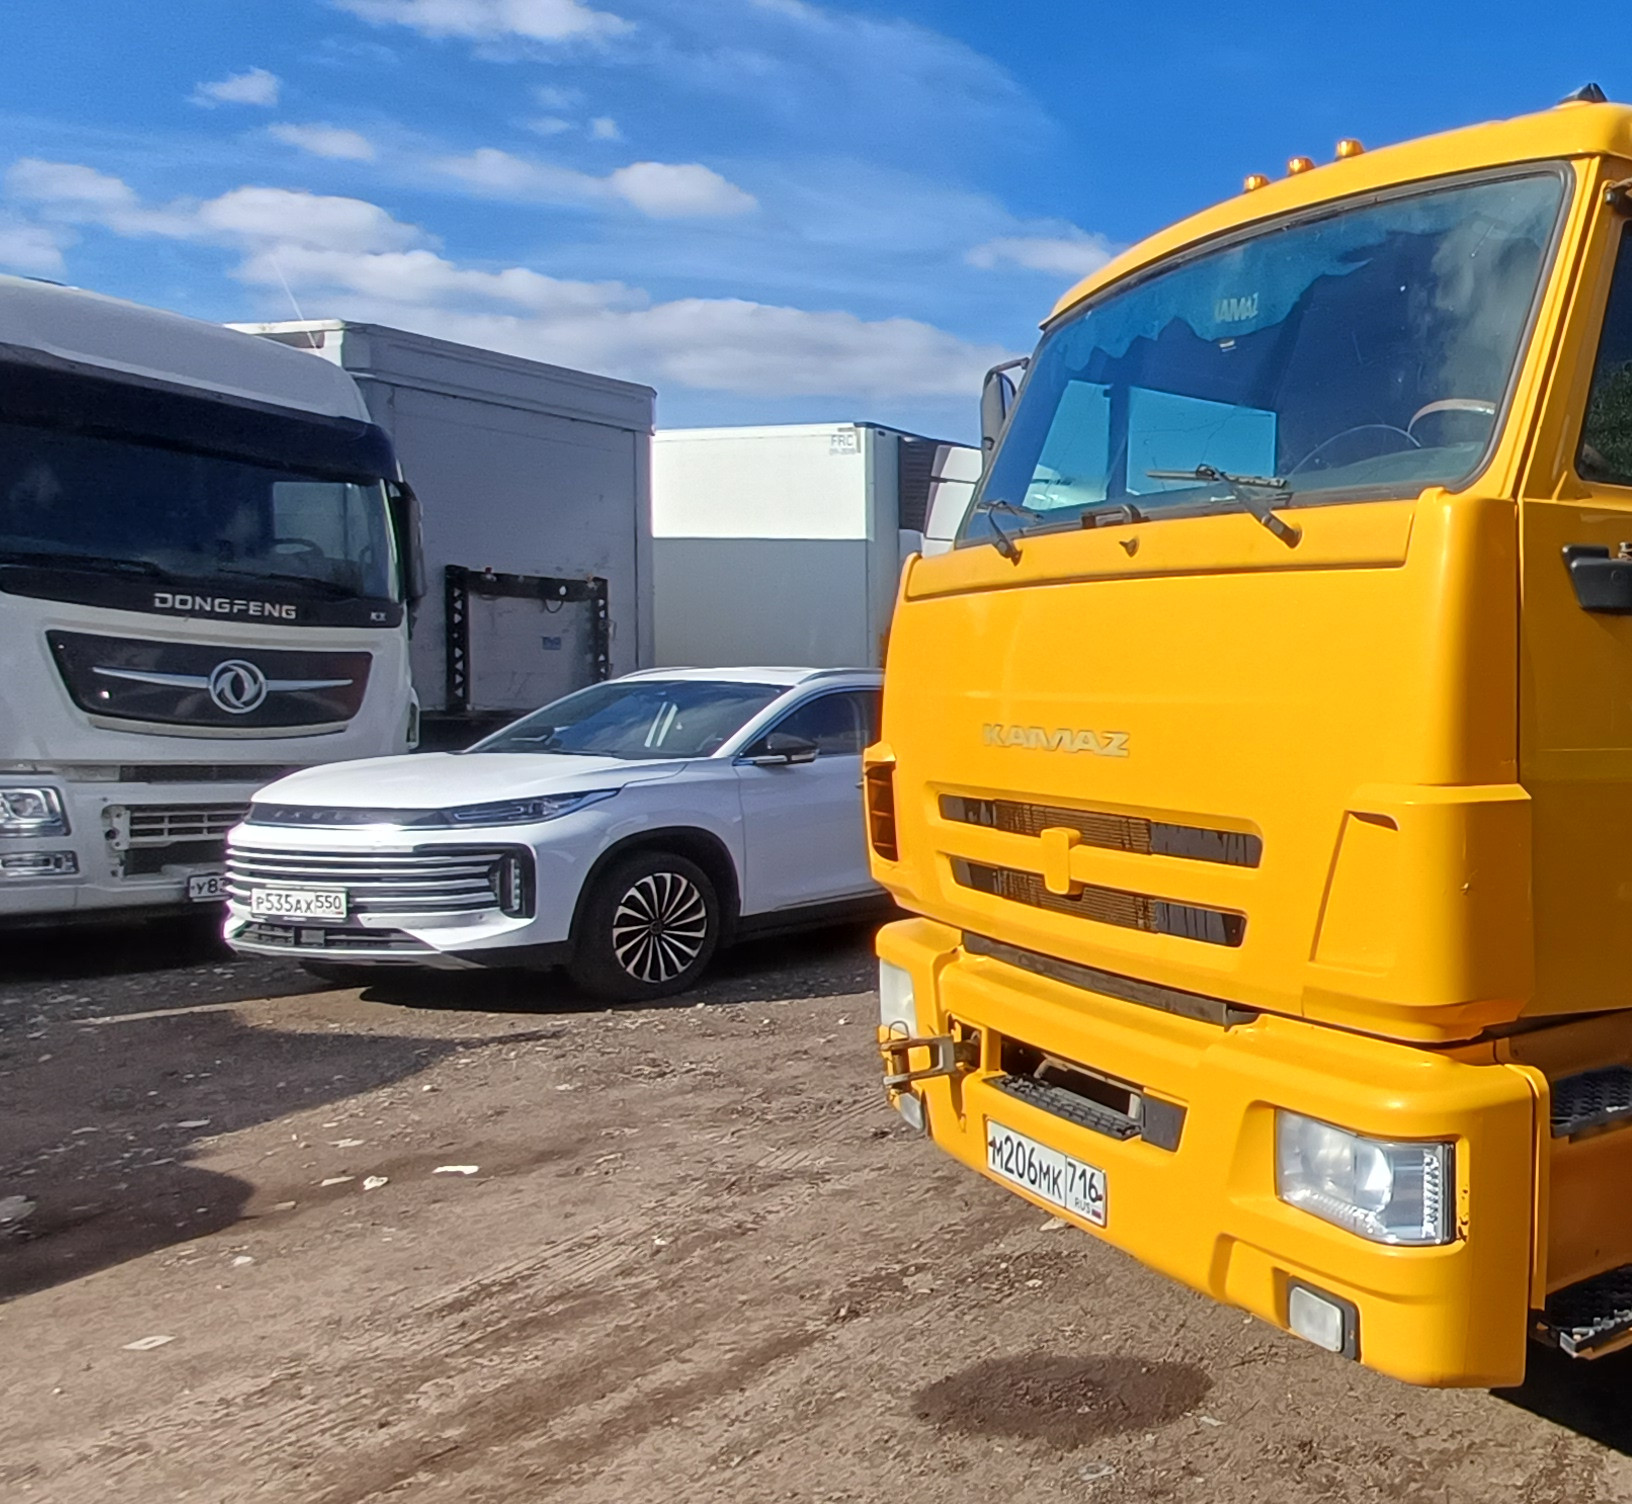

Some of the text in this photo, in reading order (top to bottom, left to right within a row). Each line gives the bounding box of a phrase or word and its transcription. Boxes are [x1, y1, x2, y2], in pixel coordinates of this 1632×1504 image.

[831, 434, 853, 446] FRC
[154, 592, 297, 619] DONGFENG
[983, 723, 1130, 758] KAMAZ
[1067, 1161, 1100, 1203] 716
[1074, 1197, 1091, 1215] RUS
